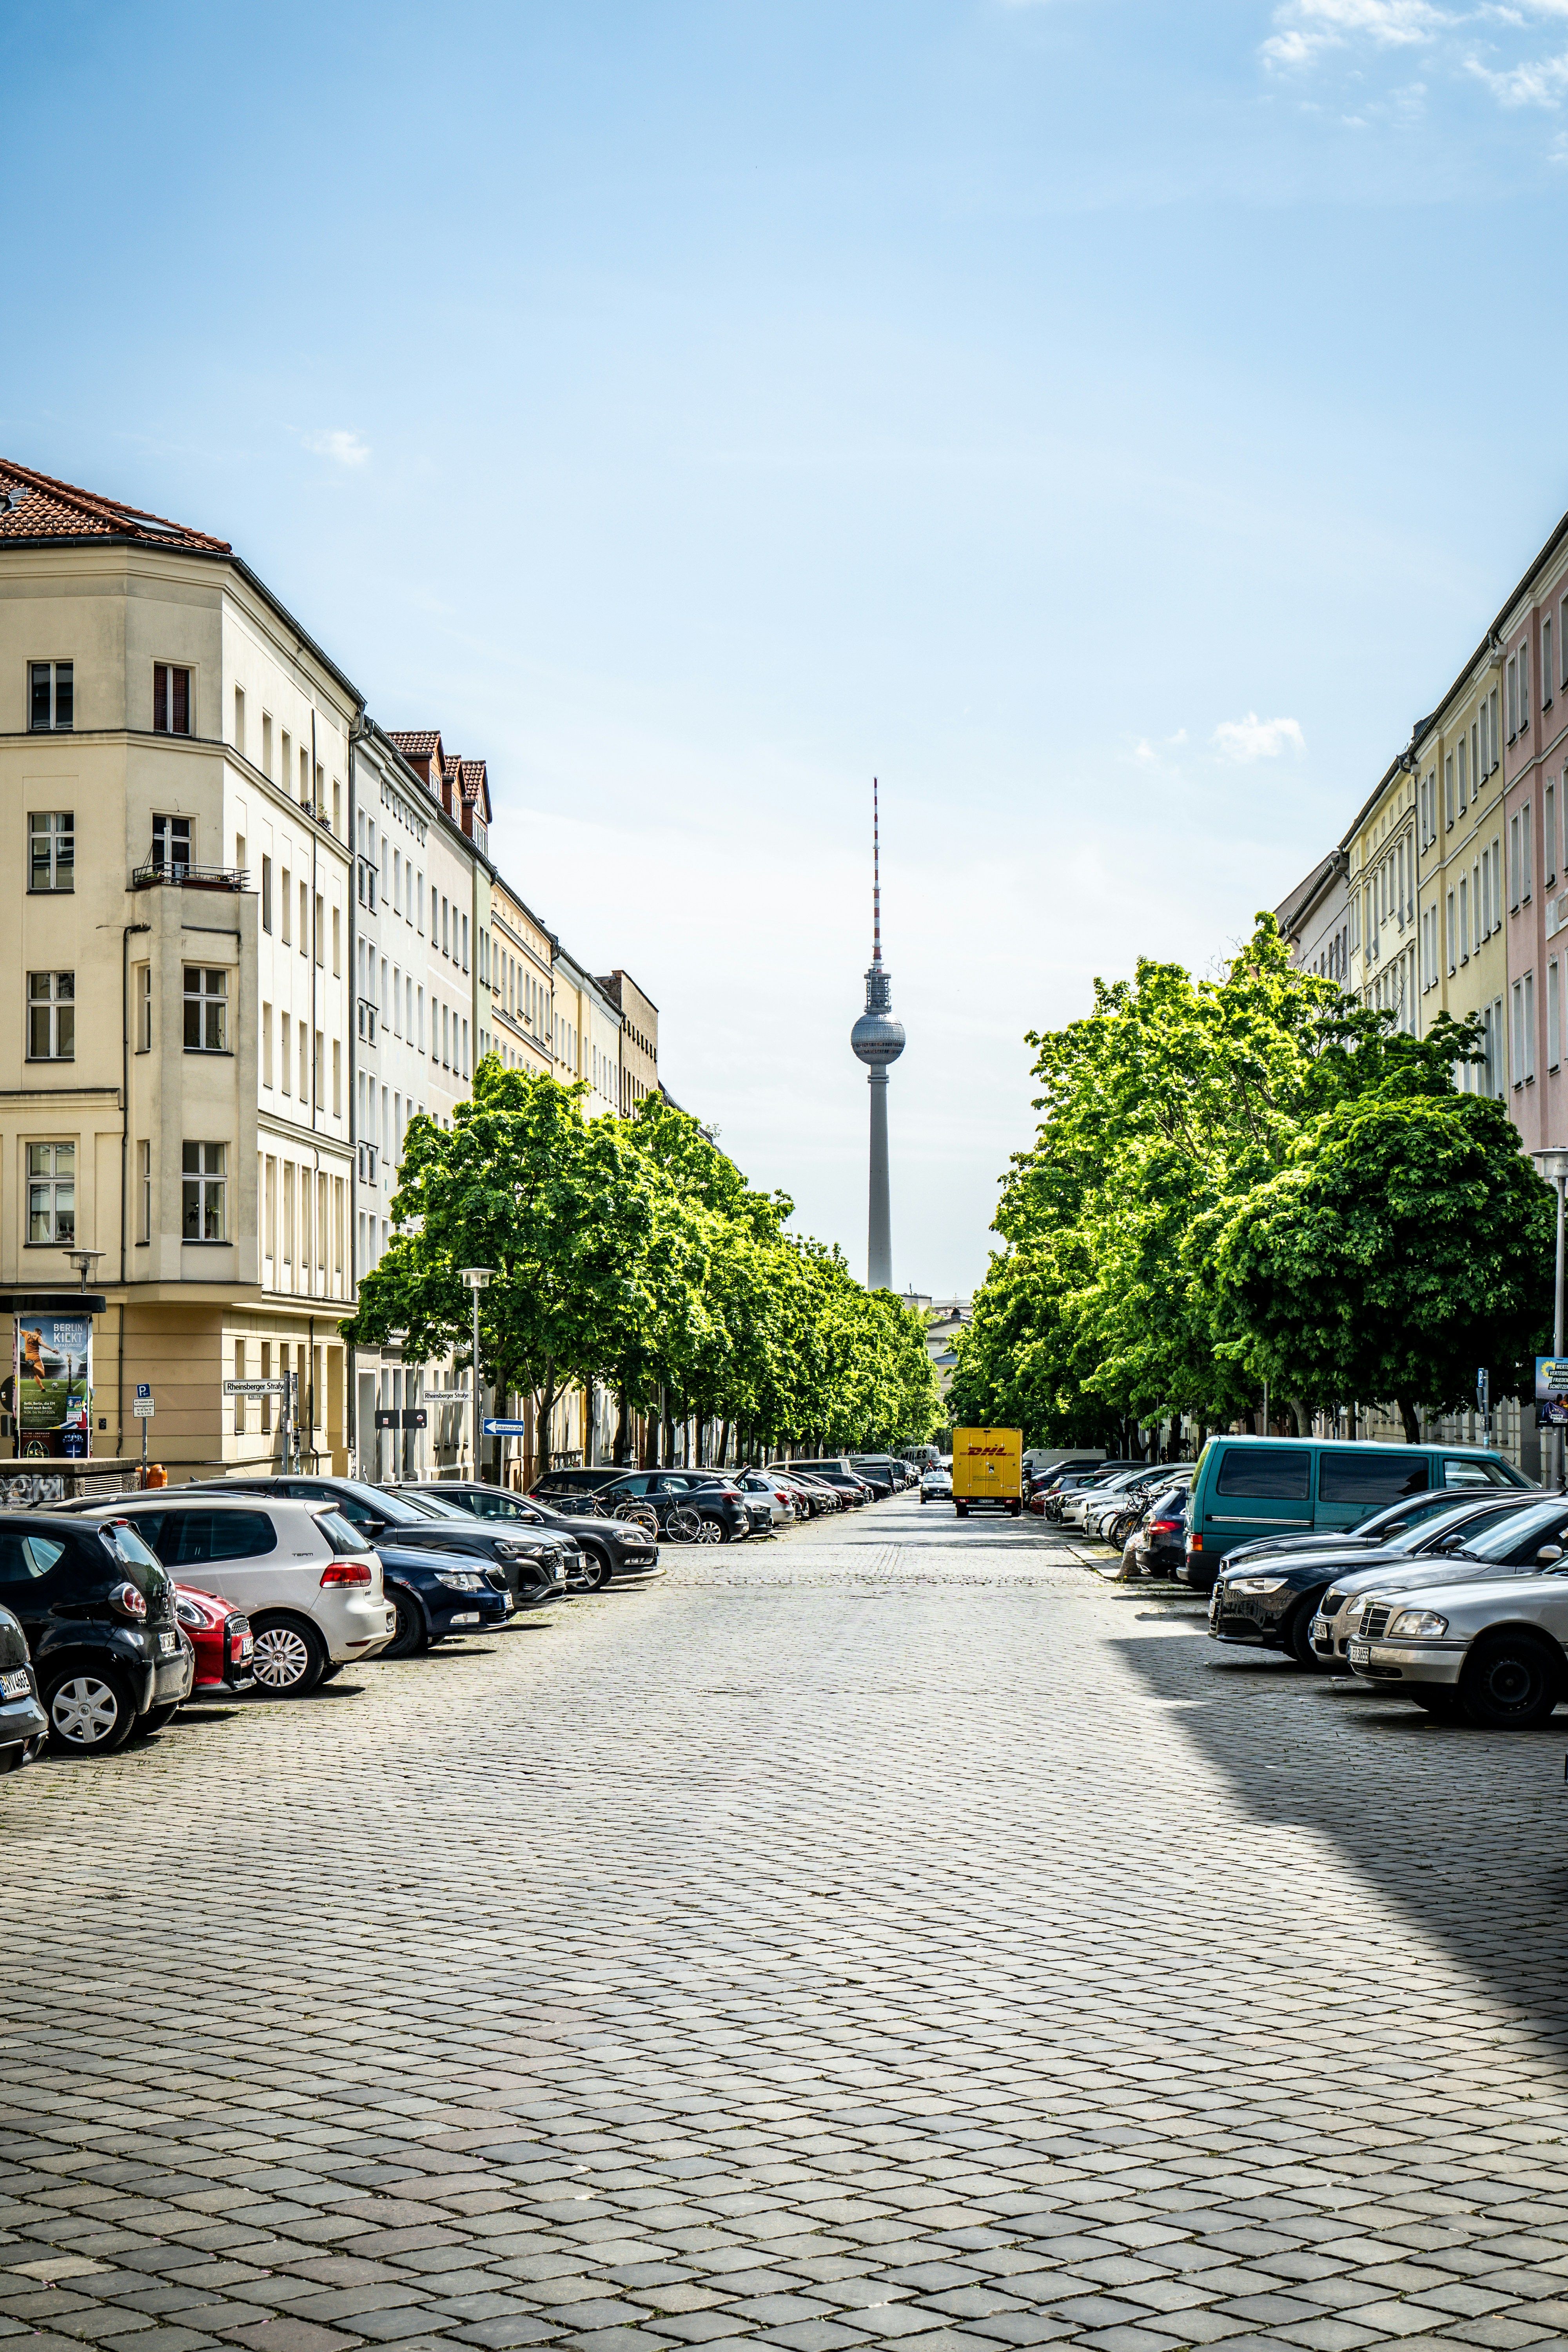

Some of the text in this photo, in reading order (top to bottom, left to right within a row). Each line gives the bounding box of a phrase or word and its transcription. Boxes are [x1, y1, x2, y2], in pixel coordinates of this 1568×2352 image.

[54, 1332, 82, 1342] KIEKT
[227, 1383, 265, 1391] Rheinsberger
[900, 1449, 927, 1461] MILES
[967, 1447, 1007, 1456] DHL
[1357, 1648, 1368, 1662] 3655
[5, 1675, 16, 1691] YV
[14, 1671, 29, 1690] 466E
